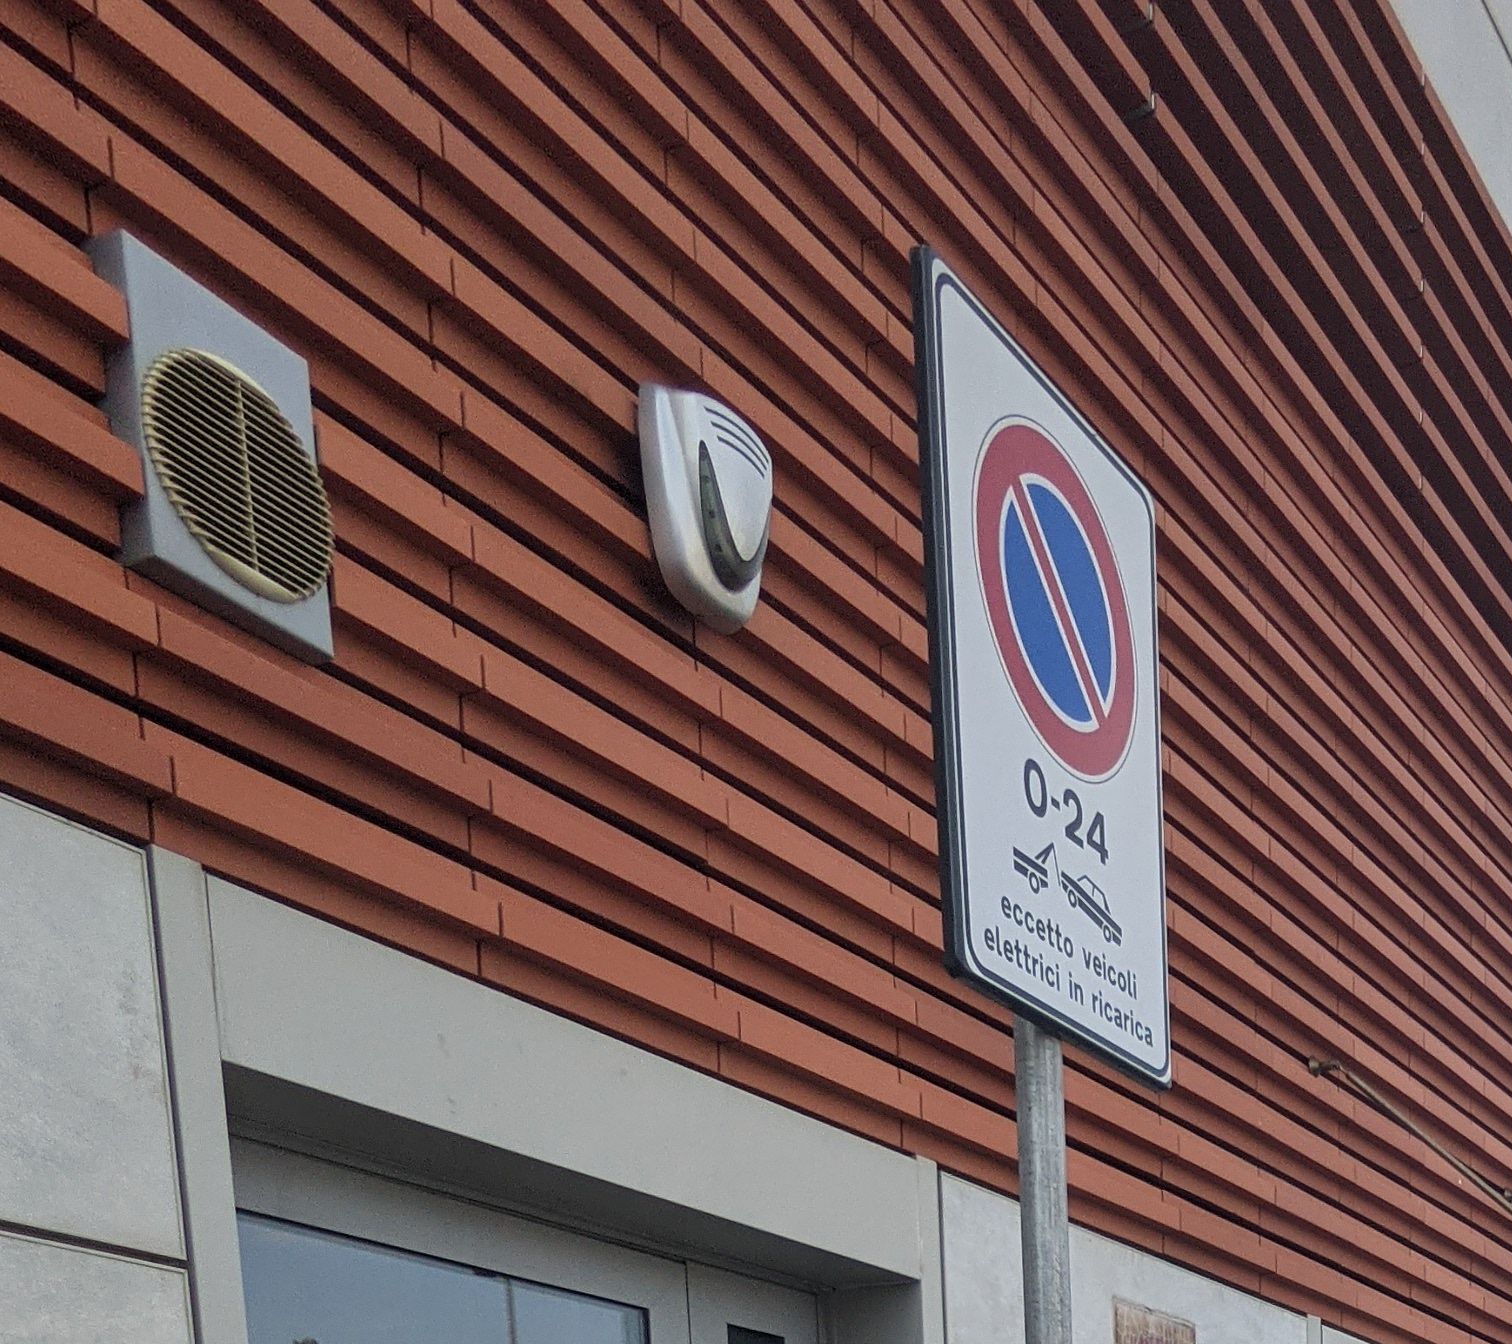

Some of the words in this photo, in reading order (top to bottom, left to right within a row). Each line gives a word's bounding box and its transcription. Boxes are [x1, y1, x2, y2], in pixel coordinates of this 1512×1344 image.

[1023, 758, 1109, 866] 0-24
[984, 925, 1061, 991] elettrici
[1068, 972, 1084, 1005] in
[1091, 991, 1153, 1047] ricarica
[1001, 895, 1074, 958] eccetto
[1082, 947, 1137, 1000] veicoli
